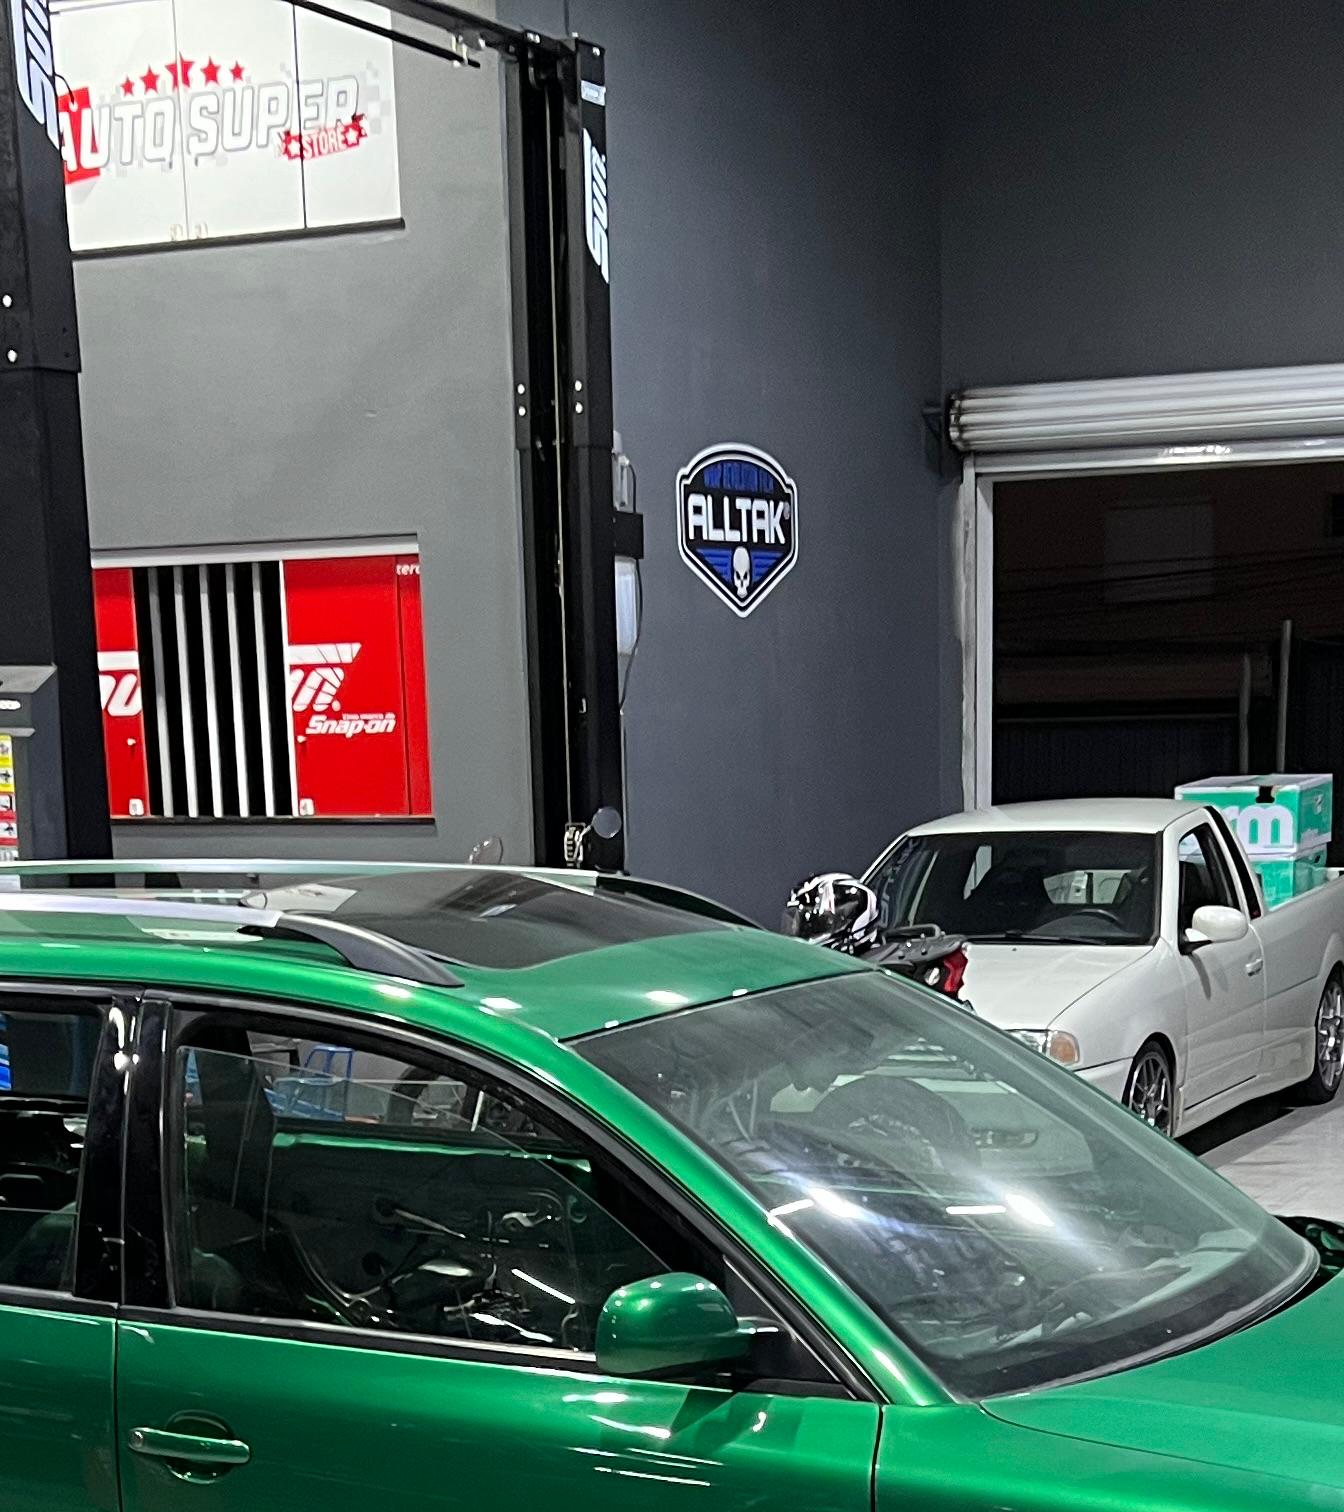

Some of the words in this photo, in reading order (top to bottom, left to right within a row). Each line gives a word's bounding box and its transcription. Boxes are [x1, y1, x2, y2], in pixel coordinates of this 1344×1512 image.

[187, 75, 359, 164] SUPER
[302, 124, 346, 160] STORE
[687, 493, 786, 545] ALLTAK
[305, 713, 397, 739] Snap-on
